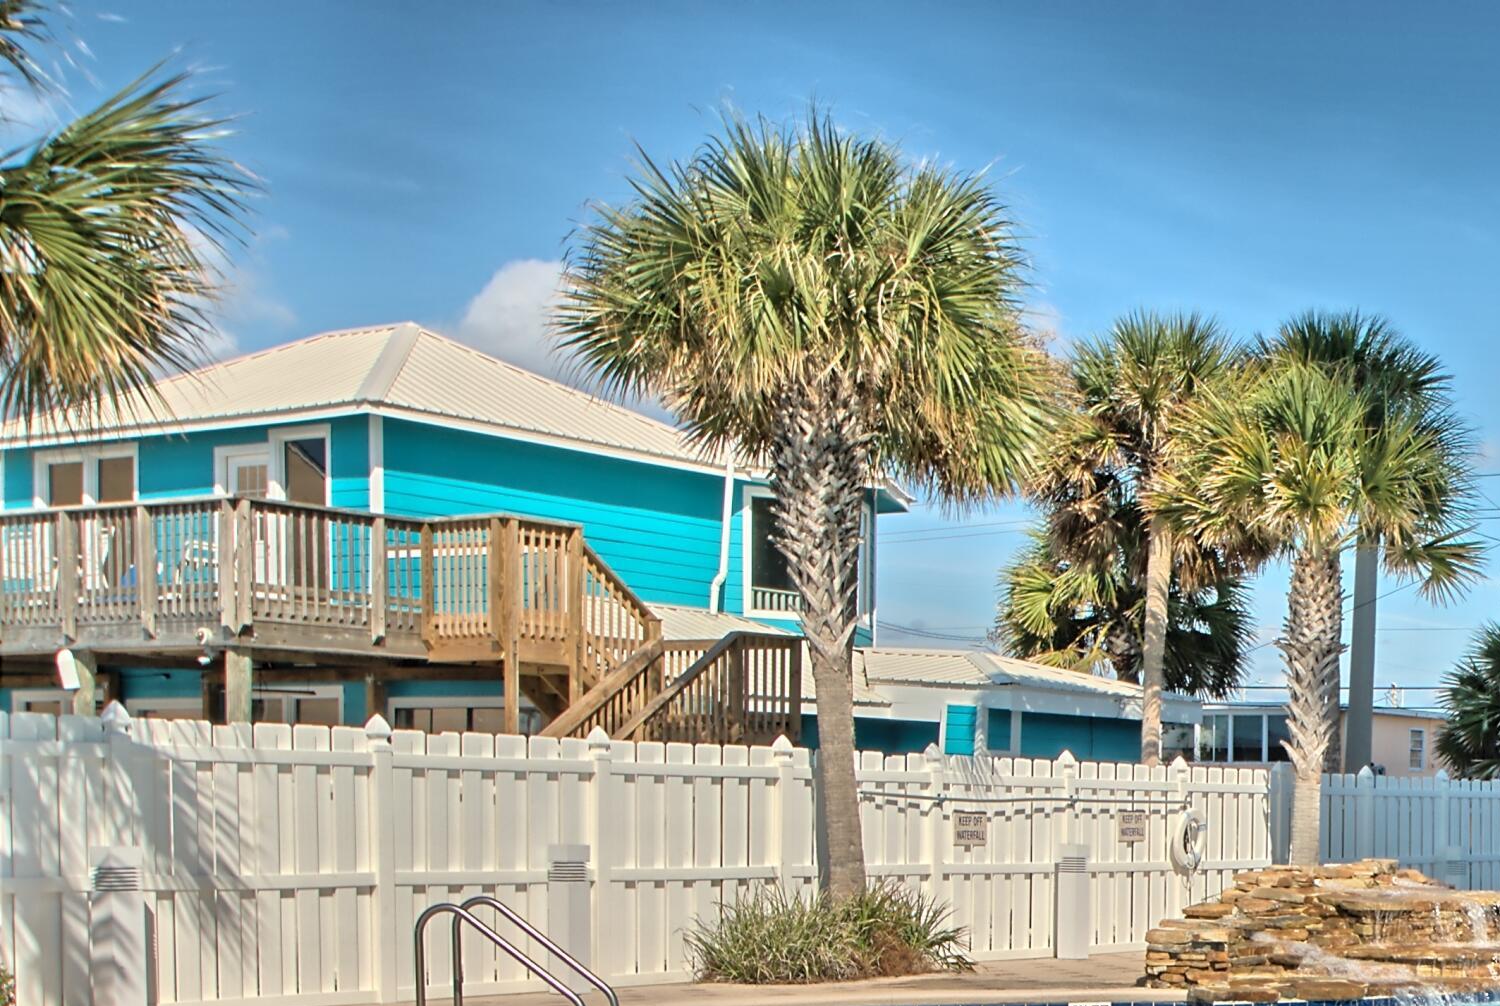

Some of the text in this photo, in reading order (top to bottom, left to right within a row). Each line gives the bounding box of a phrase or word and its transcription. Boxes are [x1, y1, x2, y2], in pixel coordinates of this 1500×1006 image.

[959, 816, 983, 826] KEEP OFF
[1122, 814, 1143, 824] KEEP OFF
[957, 830, 985, 840] WATERFALL
[1121, 828, 1144, 837] WATERFALL
